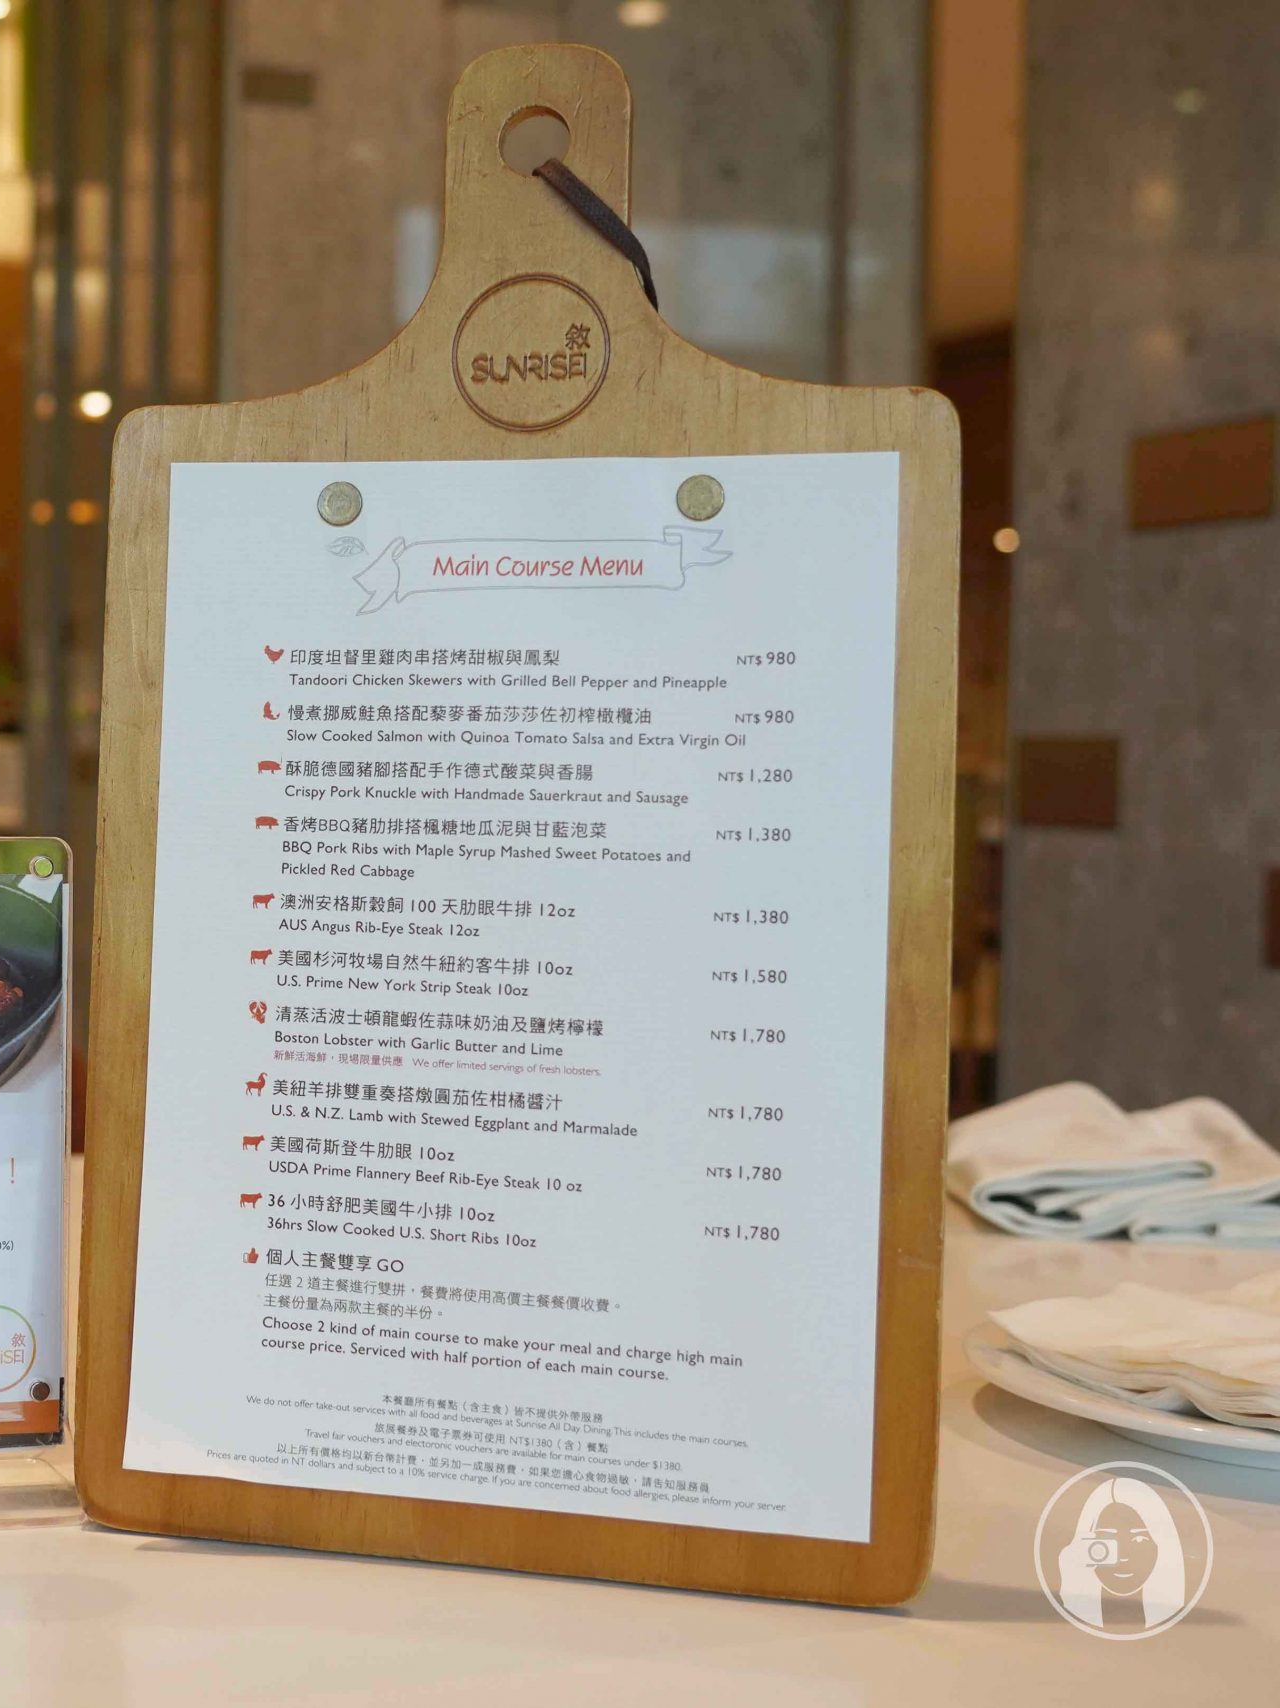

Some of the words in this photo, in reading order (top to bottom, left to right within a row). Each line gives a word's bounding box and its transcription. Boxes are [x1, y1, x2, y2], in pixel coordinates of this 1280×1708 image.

[431, 553, 489, 576] Main
[495, 555, 574, 577] Course
[579, 555, 643, 576] Menu
[736, 654, 763, 666] NT$
[765, 650, 796, 665] 980
[288, 672, 348, 686] Tandoori
[351, 672, 404, 686] Chicken
[407, 672, 463, 686] Skewers
[466, 673, 496, 686] with
[500, 673, 547, 687] Grilled
[551, 674, 576, 687] Bell
[580, 674, 629, 691] Pepper
[632, 675, 658, 688] and
[661, 675, 728, 692] Pineapple
[734, 712, 761, 725] NT$
[763, 709, 795, 724] 980
[717, 770, 744, 783] NT$
[749, 767, 793, 783] 1,280
[283, 784, 327, 801] Crispy
[329, 784, 361, 798] Pork
[364, 785, 417, 799] Knuckle
[420, 786, 449, 799] with
[453, 786, 525, 801] Handmade
[528, 787, 603, 802] Sauerkraut
[606, 790, 631, 803] and
[635, 790, 689, 807] Sausage
[715, 829, 742, 842] NT$
[748, 826, 792, 842] 1,380
[280, 861, 326, 875] Pickled
[330, 862, 356, 876] Red
[359, 863, 415, 881] Cabbage
[410, 898, 437, 913] 100
[539, 902, 576, 918] 12oz
[712, 911, 740, 924] NT$
[745, 908, 789, 925] 1,380
[278, 917, 308, 931] AUS
[310, 918, 351, 935] Angus
[355, 920, 404, 937] Rib-Eye
[407, 921, 444, 935] Steak
[449, 923, 480, 937] 12oz
[537, 960, 573, 976] 10oz
[711, 970, 738, 983] NT$
[744, 968, 788, 984] 1,580
[276, 973, 302, 987] U.S.
[305, 974, 343, 989] Prime
[347, 976, 380, 990] New
[382, 977, 416, 992] York
[419, 979, 452, 997] Strip
[455, 980, 492, 995] Steak
[497, 982, 529, 997] 10oz
[274, 1029, 319, 1044] Boston
[323, 1032, 374, 1047] Lobster
[377, 1035, 406, 1048] with
[410, 1036, 450, 1051] Garlic
[454, 1038, 498, 1053] Butter
[501, 1041, 526, 1055] and
[530, 1041, 563, 1056] Lime
[709, 1029, 737, 1042] NT$
[742, 1027, 786, 1044] 1,780
[270, 1103, 296, 1117] U.S.
[299, 1105, 311, 1118] &
[314, 1105, 344, 1120] N.Z.
[348, 1107, 384, 1122] Lamb
[387, 1111, 417, 1124] with
[420, 1111, 470, 1127] Stewed
[474, 1114, 530, 1133] Eggplant
[533, 1119, 558, 1132] and
[562, 1120, 638, 1137] Marmalade
[707, 1106, 734, 1120] NT$
[740, 1105, 784, 1122] 1,780
[419, 1145, 455, 1162] 10oz
[705, 1166, 733, 1179] NT$
[738, 1164, 782, 1181] 1,780
[267, 1192, 286, 1208] 36
[459, 1206, 495, 1222] 10oz
[266, 1215, 303, 1231] 36hrs
[306, 1218, 339, 1233] Slow
[342, 1221, 395, 1237] Cooked
[399, 1225, 425, 1240] U.S.
[429, 1227, 467, 1243] Short
[470, 1230, 499, 1245] Ribs
[505, 1232, 537, 1248] 10oz
[703, 1225, 731, 1239] NT$
[736, 1224, 780, 1241] 1,780
[376, 1257, 404, 1273] GO
[260, 1337, 305, 1350] course
[308, 1340, 346, 1354] price.
[349, 1341, 406, 1359] Serviced
[409, 1347, 439, 1361] with
[443, 1349, 469, 1364] half
[470, 1355, 522, 1368] portion
[526, 1356, 542, 1370] of
[544, 1359, 576, 1373] each
[580, 1363, 613, 1376] main
[617, 1367, 669, 1380] course.
